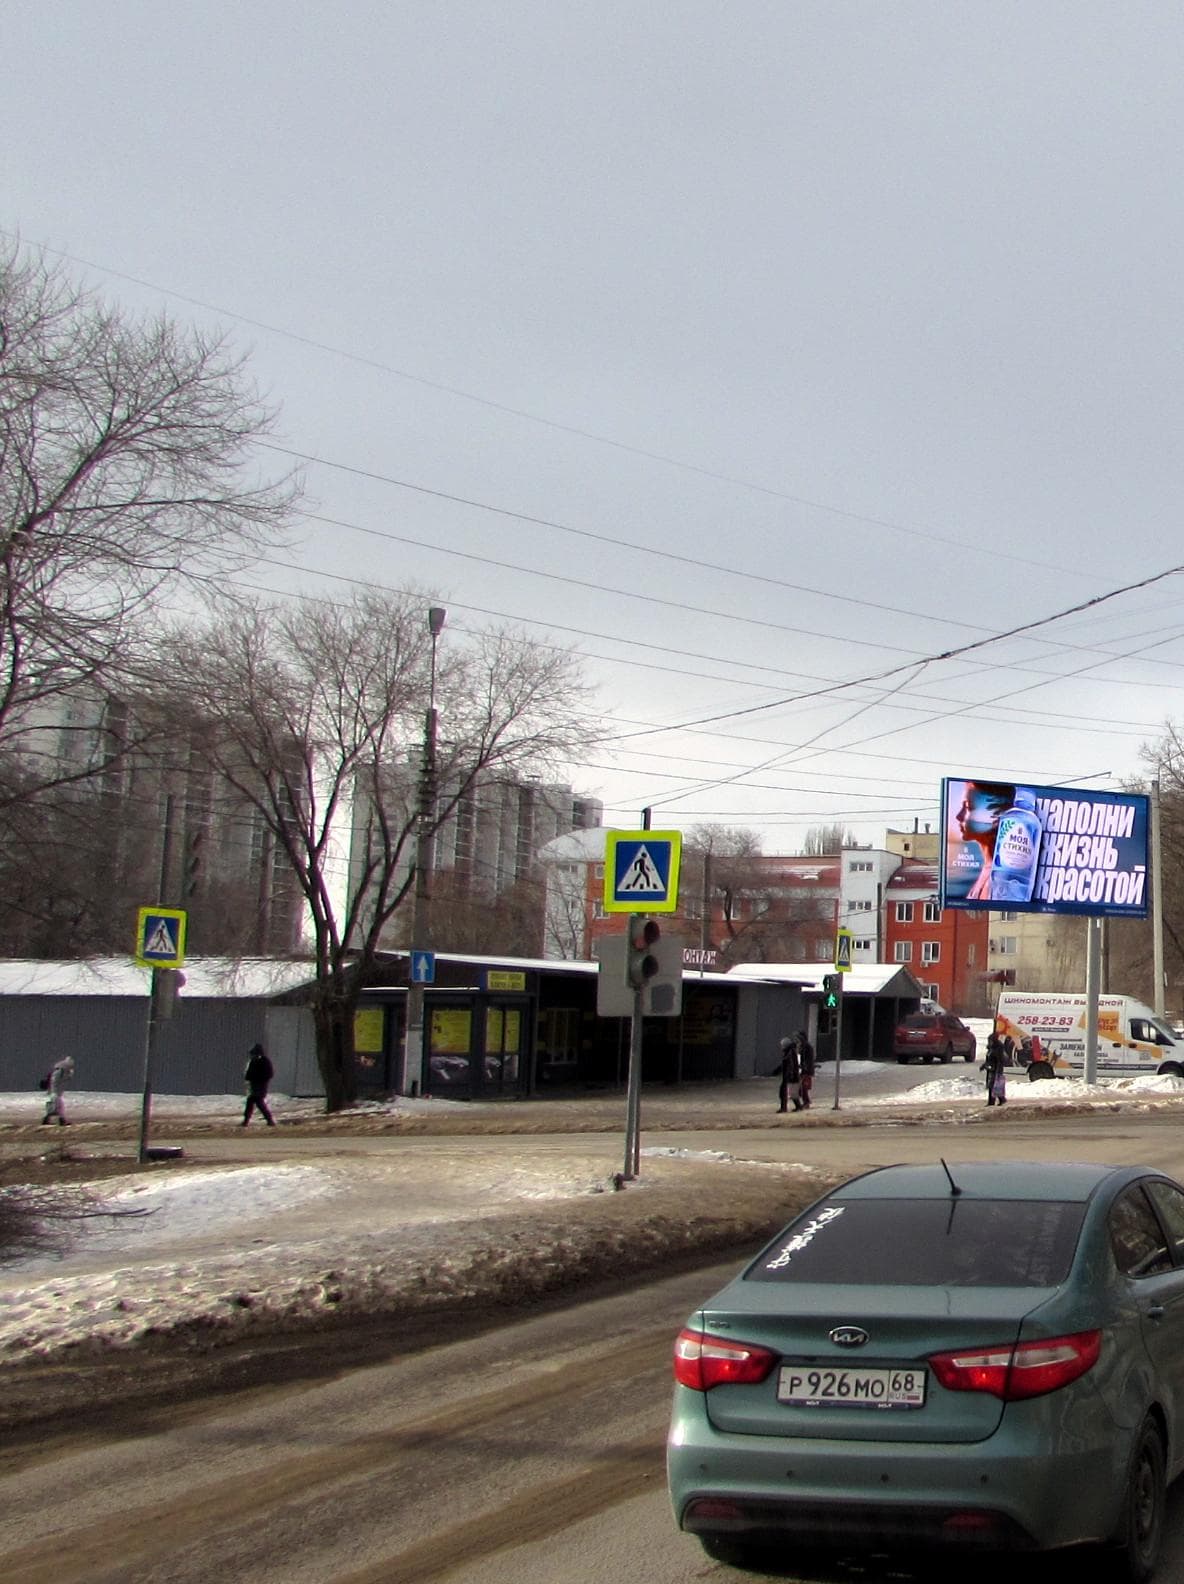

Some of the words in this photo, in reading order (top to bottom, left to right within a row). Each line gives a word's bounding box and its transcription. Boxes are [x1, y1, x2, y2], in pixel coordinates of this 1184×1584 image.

[1009, 834, 1029, 845] МОЯ
[683, 948, 717, 964] ОНТАЖ
[1004, 997, 1071, 1006] ШИНОМОНТАЖ
[1074, 999, 1124, 1007] ВЫДНОЙ
[891, 1373, 915, 1392] 68
